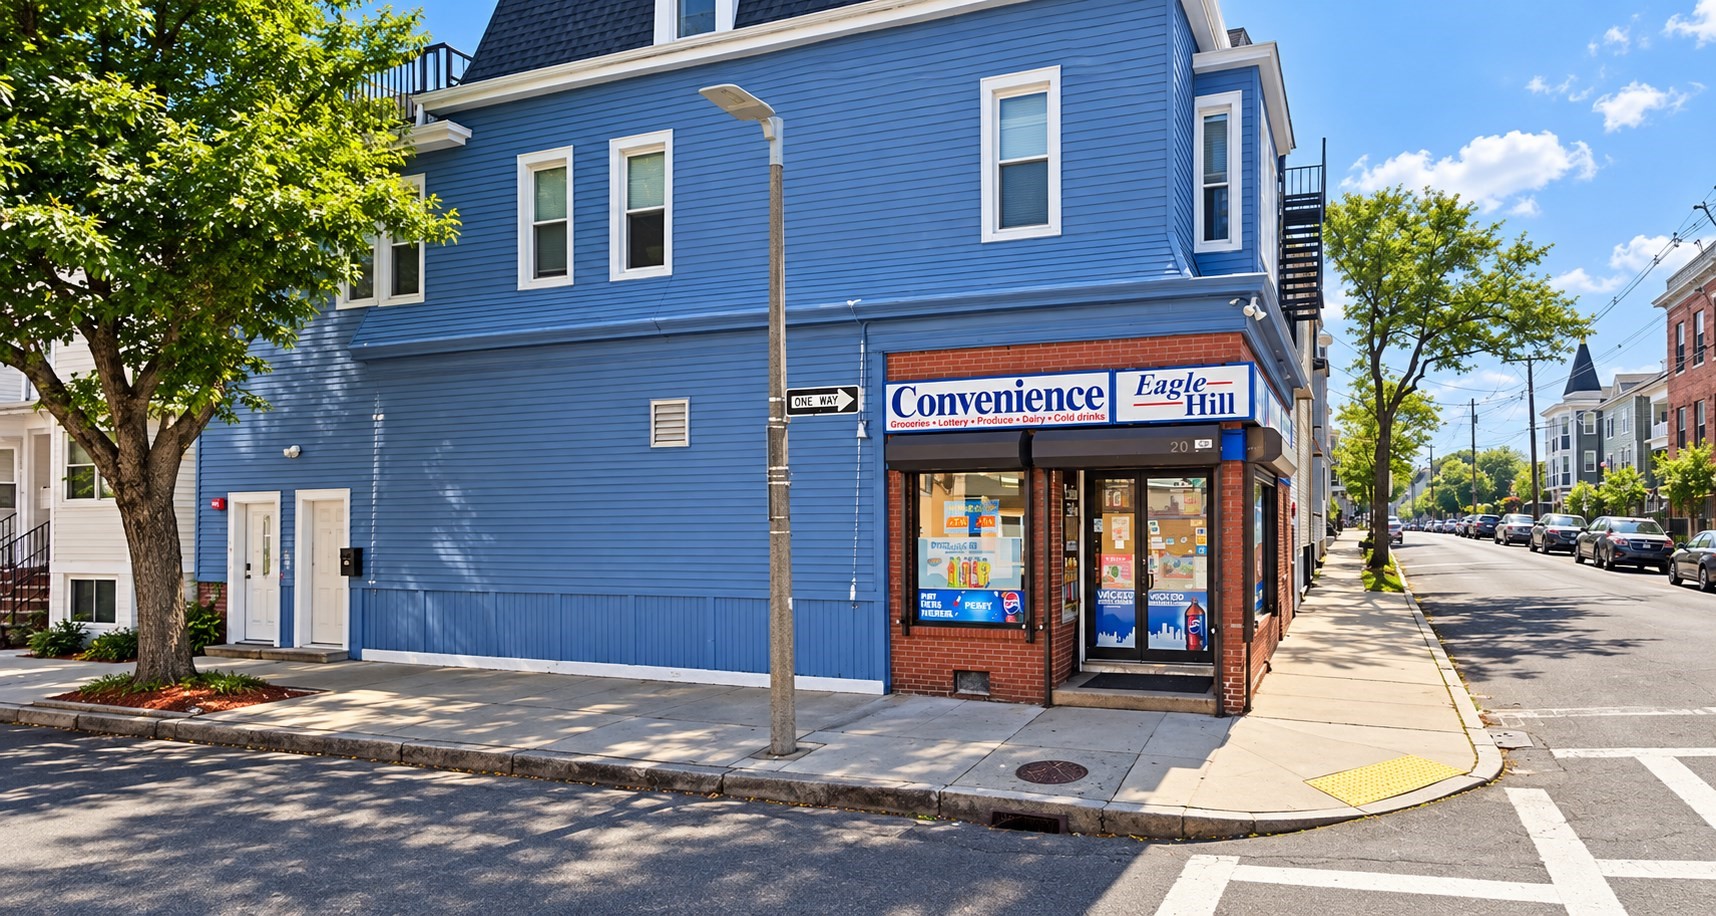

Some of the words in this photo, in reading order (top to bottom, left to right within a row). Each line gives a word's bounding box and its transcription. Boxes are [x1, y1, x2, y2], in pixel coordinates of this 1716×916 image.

[1135, 372, 1207, 400] Eagle
[794, 396, 813, 406] ONE
[819, 395, 839, 406] WAY
[892, 379, 1104, 418] Convenience
[1186, 392, 1236, 416] Hill
[938, 419, 968, 427] Lottery
[977, 416, 1013, 426] Produce
[1022, 415, 1045, 424] Dairy
[1054, 413, 1075, 422] Cold
[1077, 412, 1106, 421] drinks
[1170, 440, 1189, 453] 20
